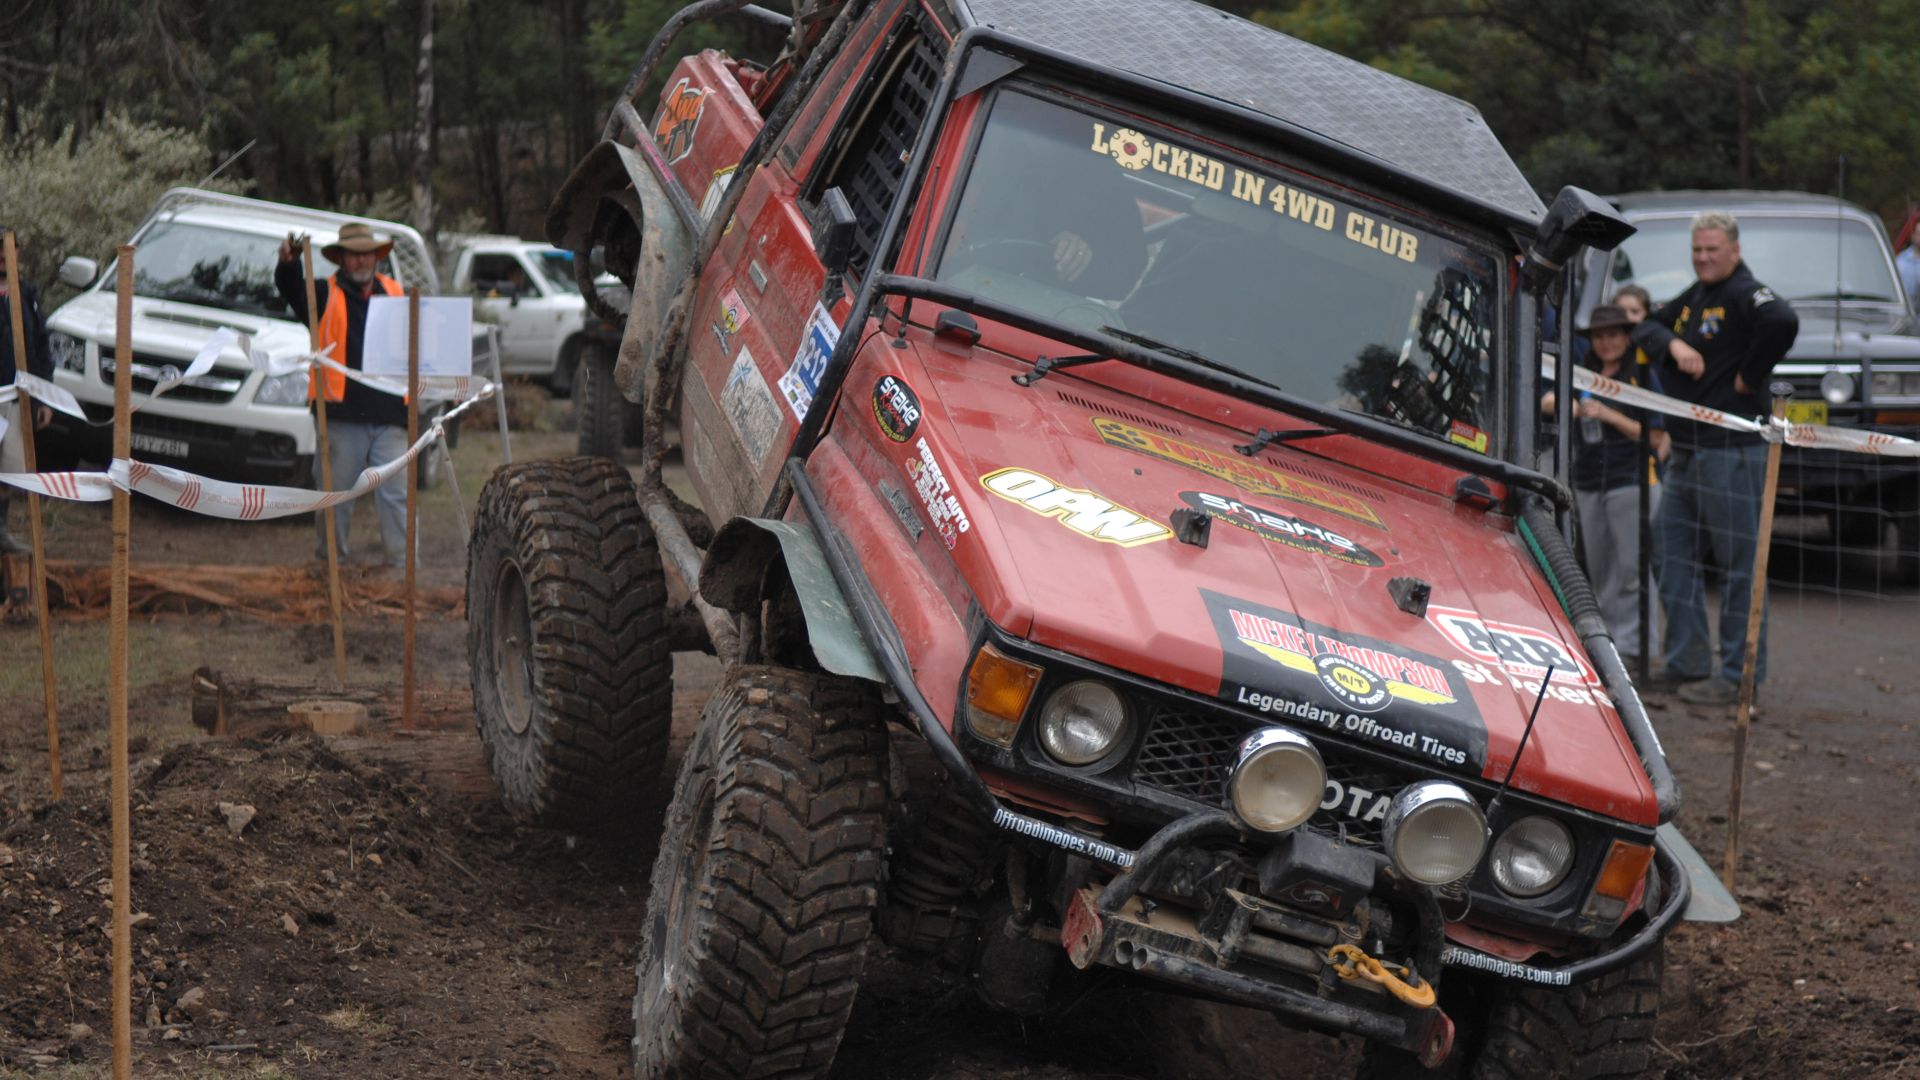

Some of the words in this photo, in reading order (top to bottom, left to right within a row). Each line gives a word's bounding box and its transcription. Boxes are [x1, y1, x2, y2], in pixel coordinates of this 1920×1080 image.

[1090, 122, 1226, 191] LOCKED
[1231, 168, 1265, 207] IN
[1269, 184, 1336, 232] 4WD
[1345, 211, 1420, 264] CLUB
[802, 336, 828, 388] 212
[916, 436, 951, 496] PERFECT
[944, 493, 971, 534] AUTO
[1149, 432, 1283, 490] TOUGH
[1286, 477, 1370, 518] DOG
[1228, 608, 1316, 658] MICKEY
[1319, 633, 1453, 698] THOMPSON
[1450, 618, 1577, 672] ARB
[1451, 658, 1503, 688] St
[1336, 671, 1365, 689] M/T
[1237, 686, 1341, 728] Legendary
[1344, 714, 1416, 750] Offroad
[1421, 732, 1467, 765] Tires
[1321, 778, 1392, 823] OTA
